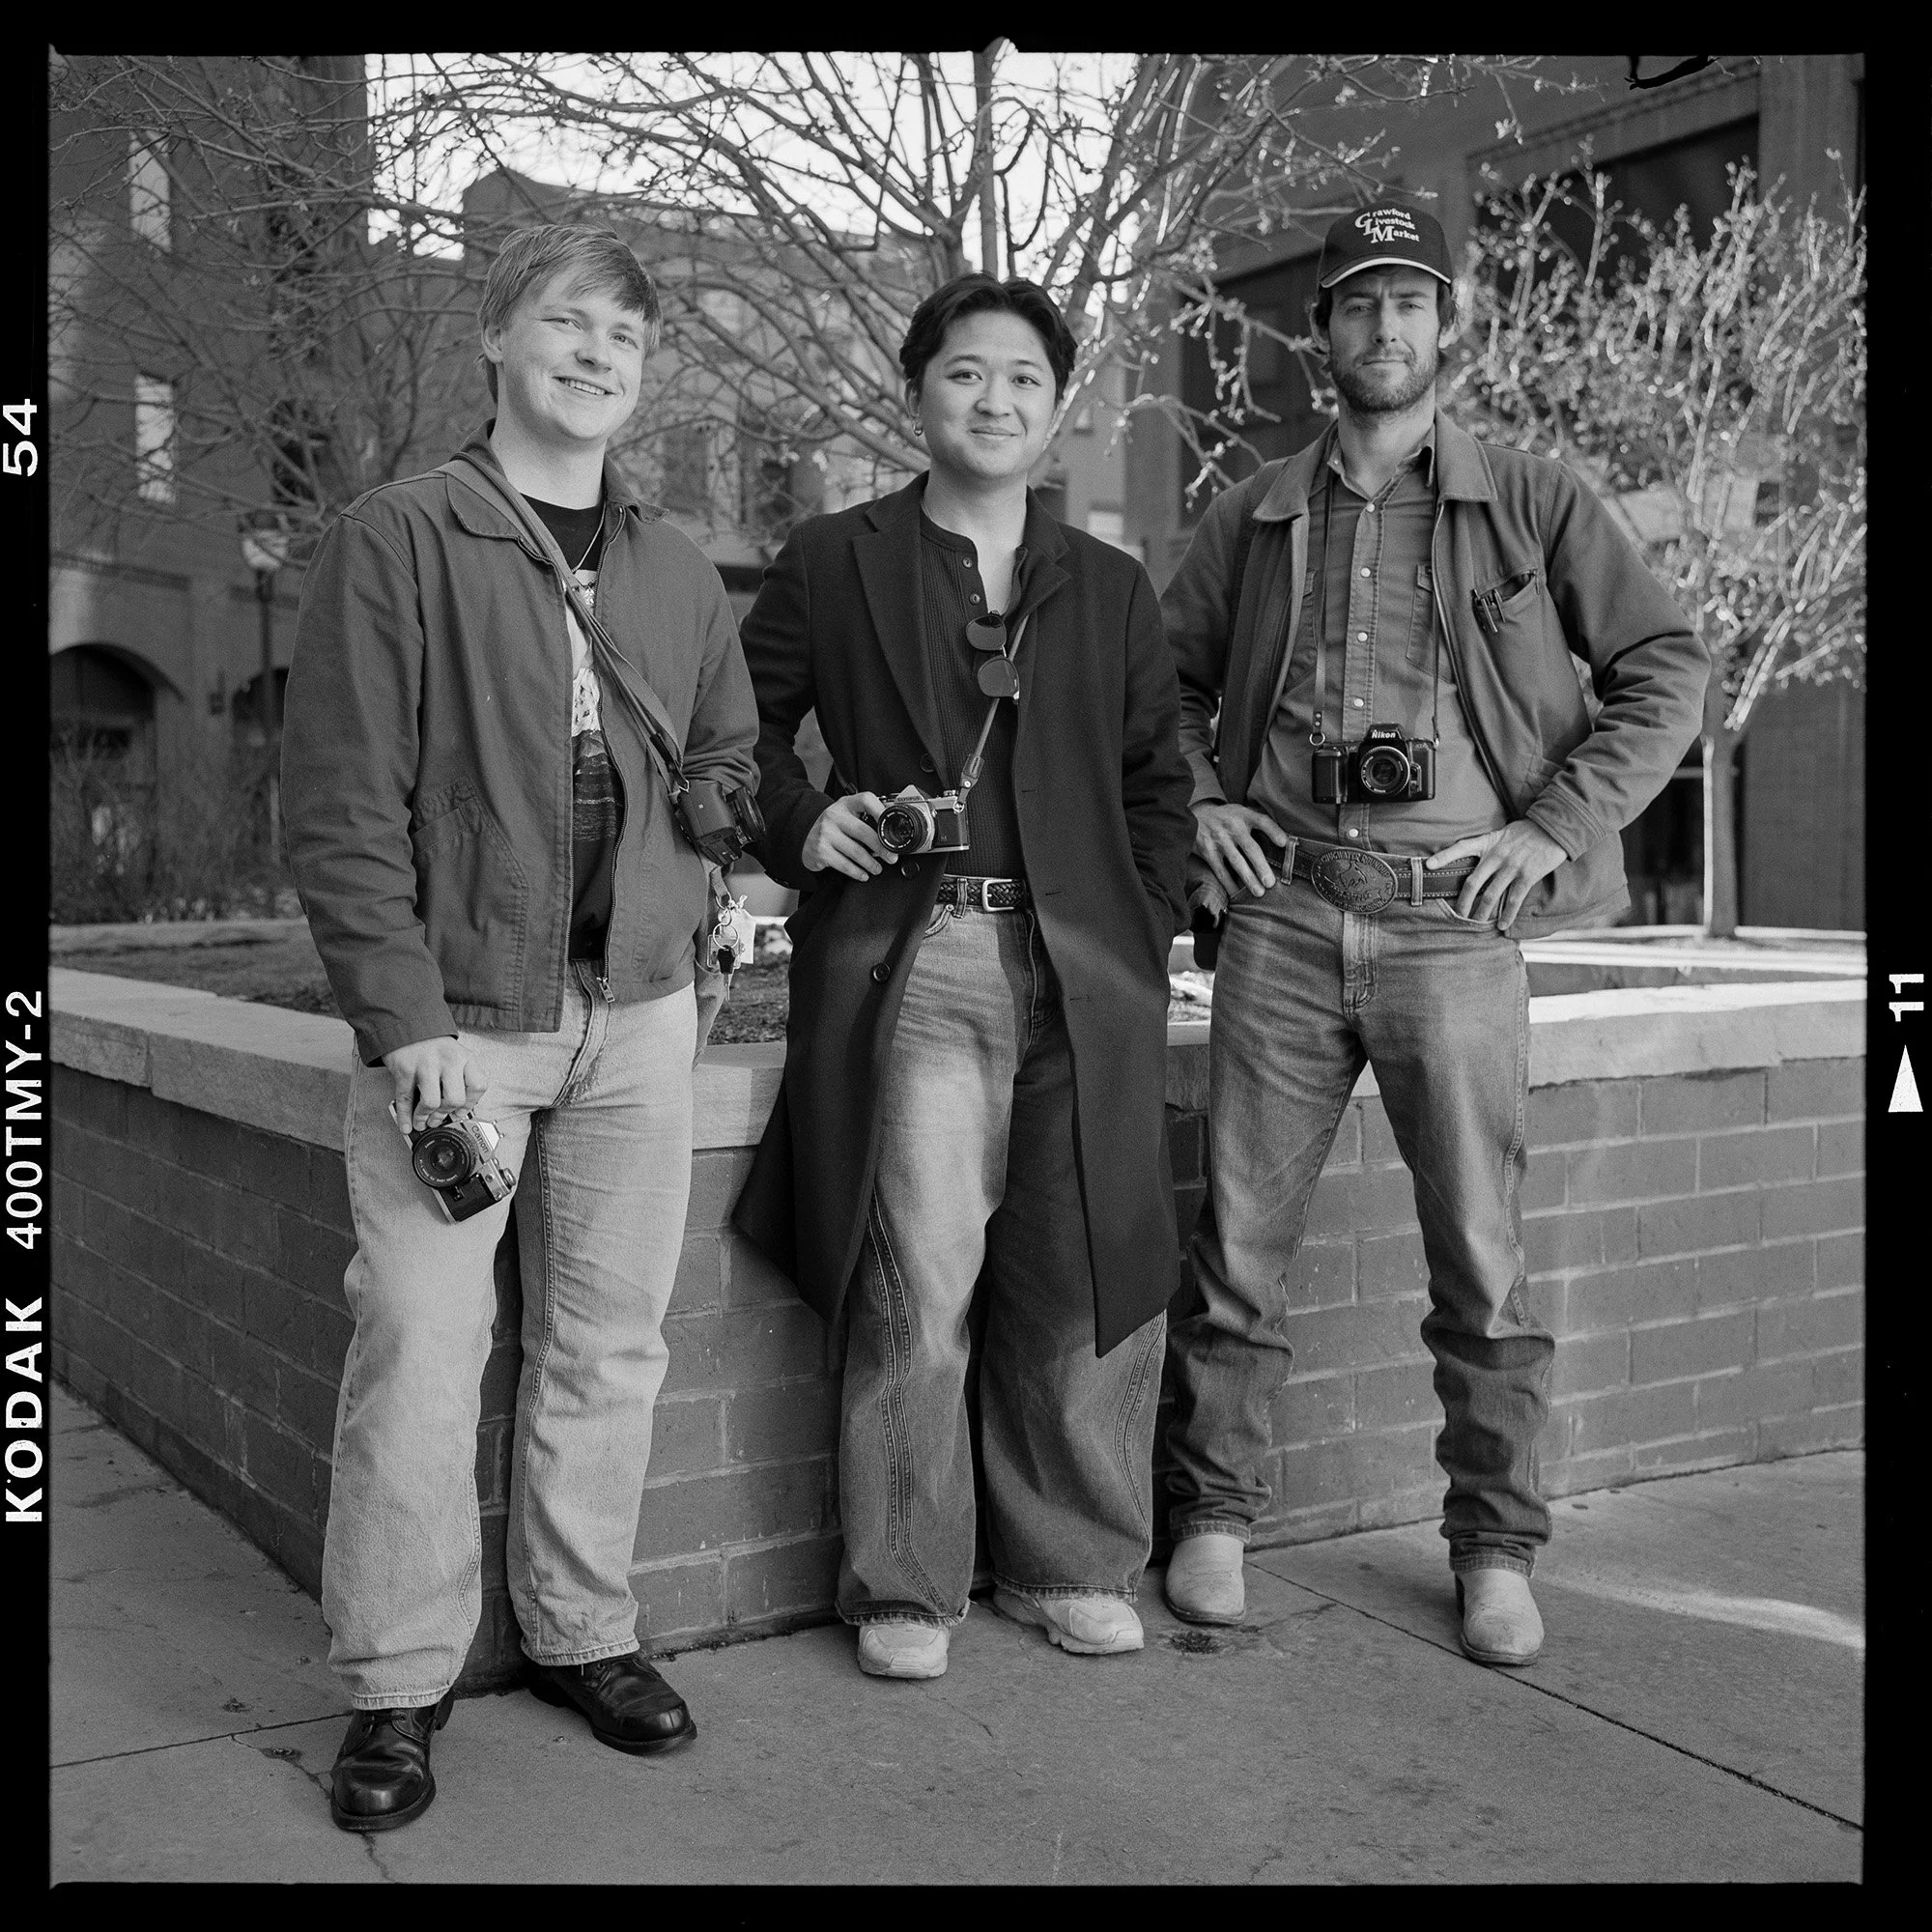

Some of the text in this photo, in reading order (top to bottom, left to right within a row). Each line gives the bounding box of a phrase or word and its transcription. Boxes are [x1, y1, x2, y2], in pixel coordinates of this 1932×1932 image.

[1354, 208, 1411, 228] Crawford
[1363, 217, 1416, 236] Livestock
[1371, 225, 1420, 243] Market
[1371, 730, 1396, 739] Nikon
[471, 1125, 490, 1153] Canon
